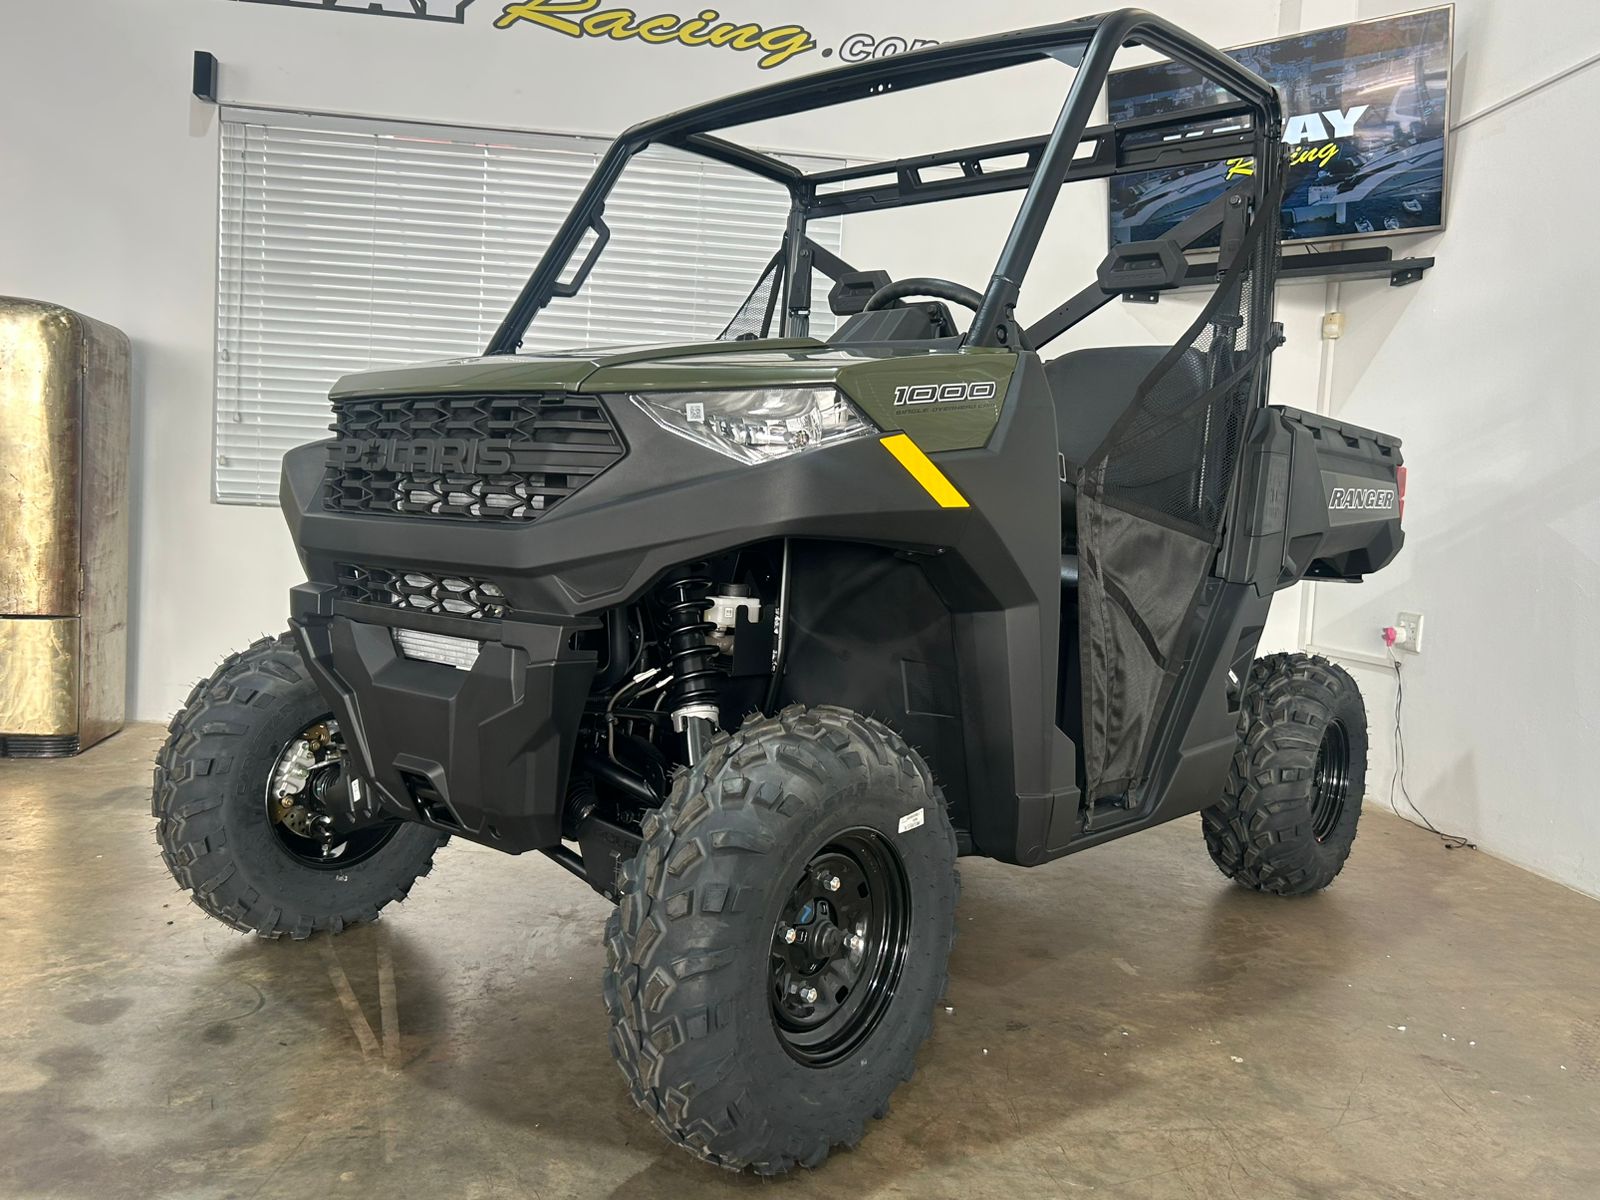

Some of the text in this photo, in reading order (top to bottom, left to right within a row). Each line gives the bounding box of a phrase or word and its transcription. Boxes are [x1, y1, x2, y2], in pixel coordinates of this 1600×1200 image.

[894, 382, 996, 406] 1000
[340, 437, 512, 475] POLARIS
[1328, 487, 1394, 510] RANGER
